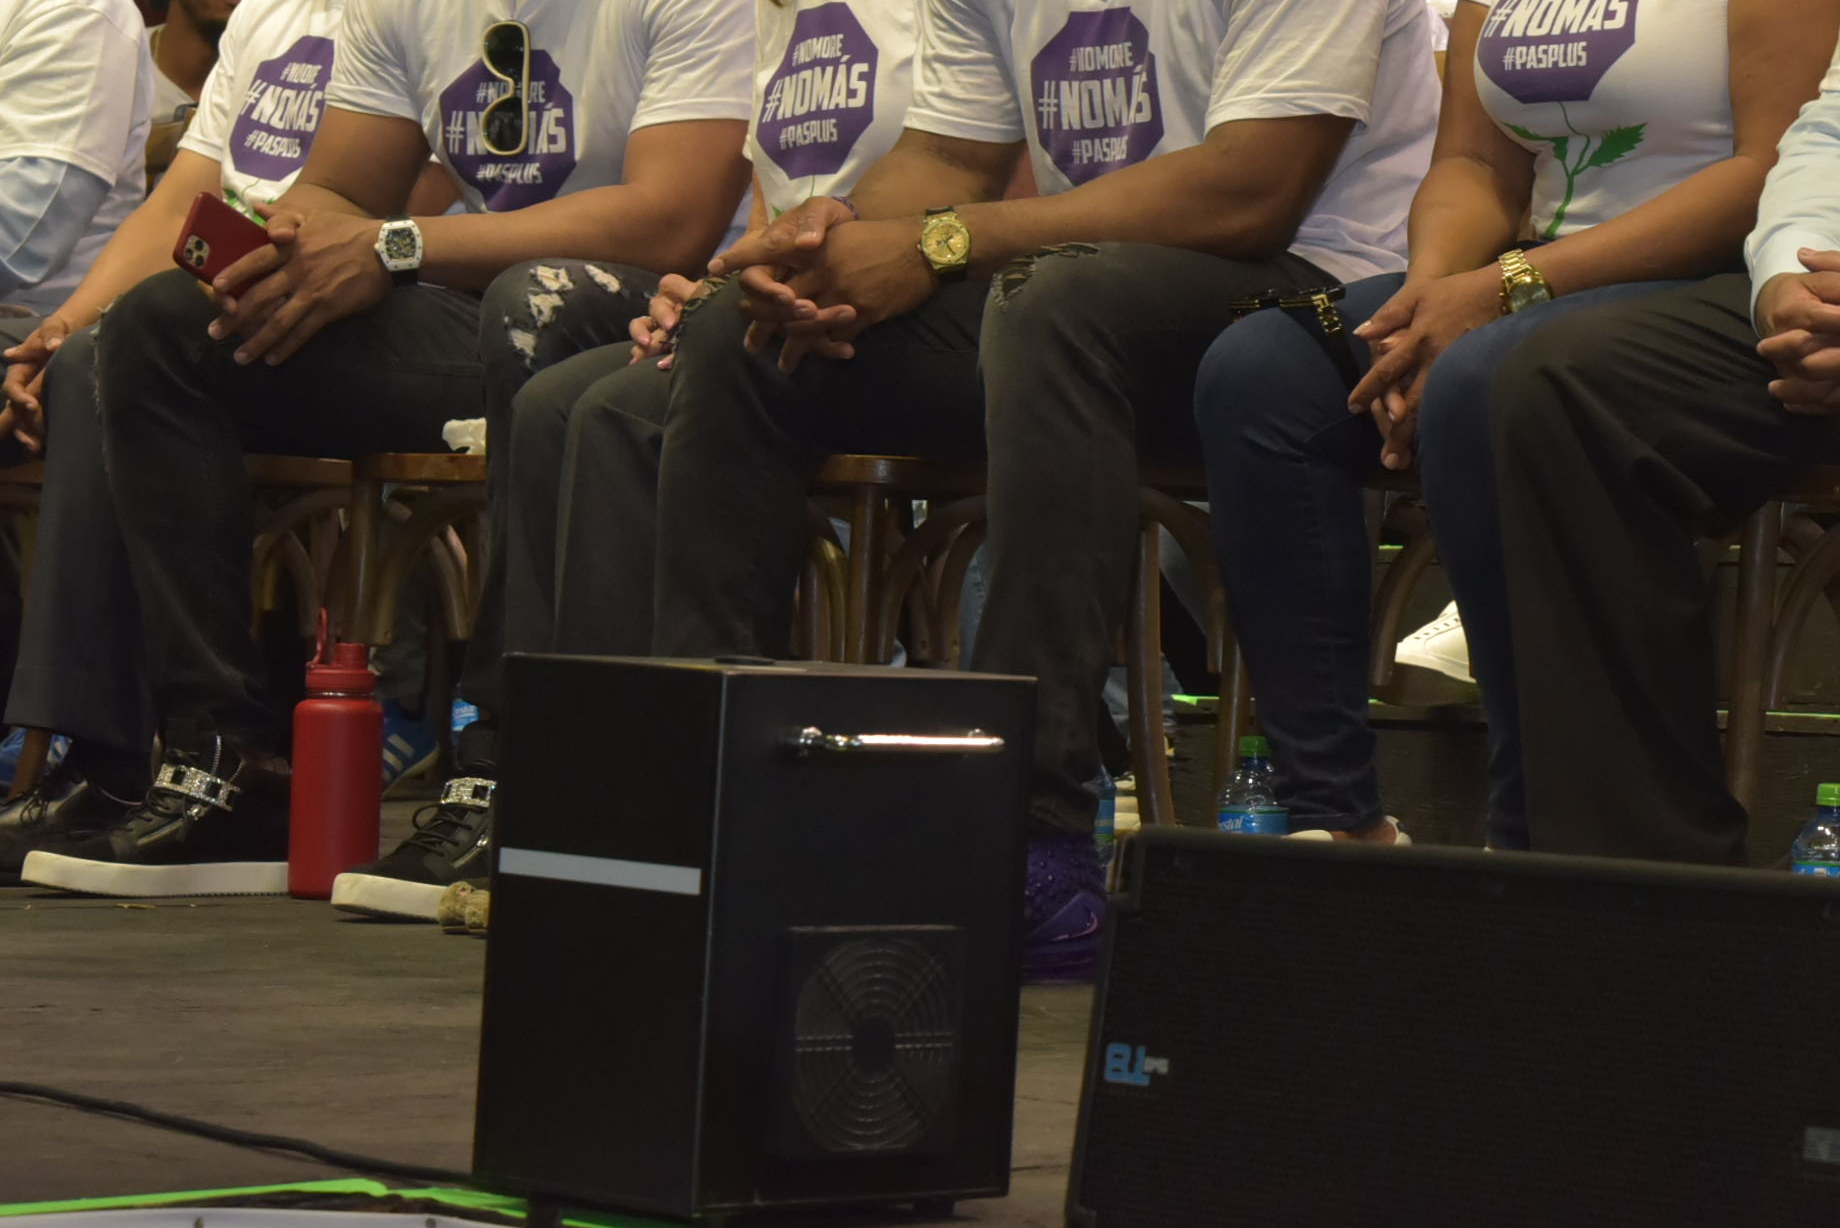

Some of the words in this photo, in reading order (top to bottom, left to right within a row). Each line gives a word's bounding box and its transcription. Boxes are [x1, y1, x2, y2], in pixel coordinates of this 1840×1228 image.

[791, 34, 845, 68] #NOMORE
[1068, 42, 1135, 73] #NOMORE
[1502, 41, 1588, 72] #PASPLUS
[761, 55, 870, 124] #NOMÁS
[778, 118, 838, 151] #PASPLUS
